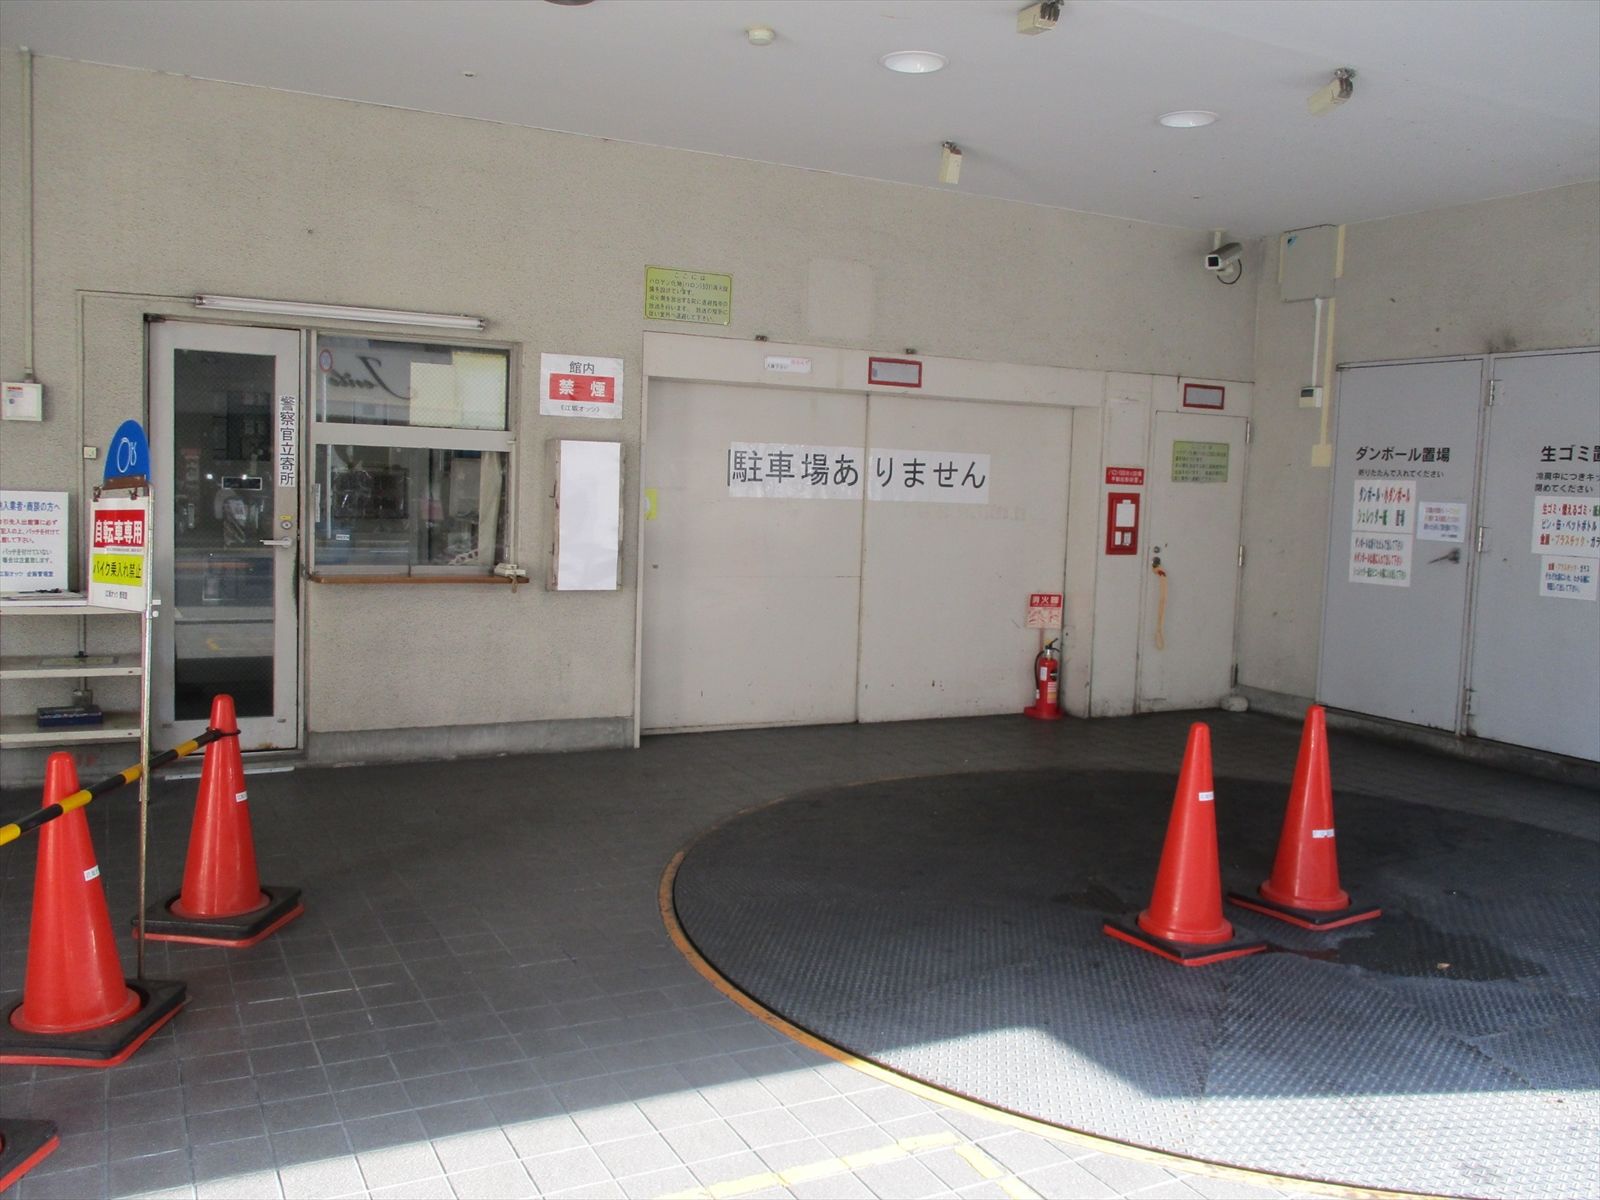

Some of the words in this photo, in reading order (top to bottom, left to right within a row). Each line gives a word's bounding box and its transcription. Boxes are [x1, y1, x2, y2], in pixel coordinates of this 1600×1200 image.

[569, 361, 595, 374] 館内
[559, 379, 605, 397] 禁煙
[280, 396, 295, 486] 警察官立寄所
[1356, 446, 1450, 462] ダンボール置場
[732, 450, 985, 488] 駐車場ありません
[1358, 469, 1444, 478] 折りたたんで入れてください
[1535, 483, 1594, 493] 閉めてください
[95, 520, 143, 544] 自転車専用
[93, 561, 142, 579] バイク乗入れ禁止
